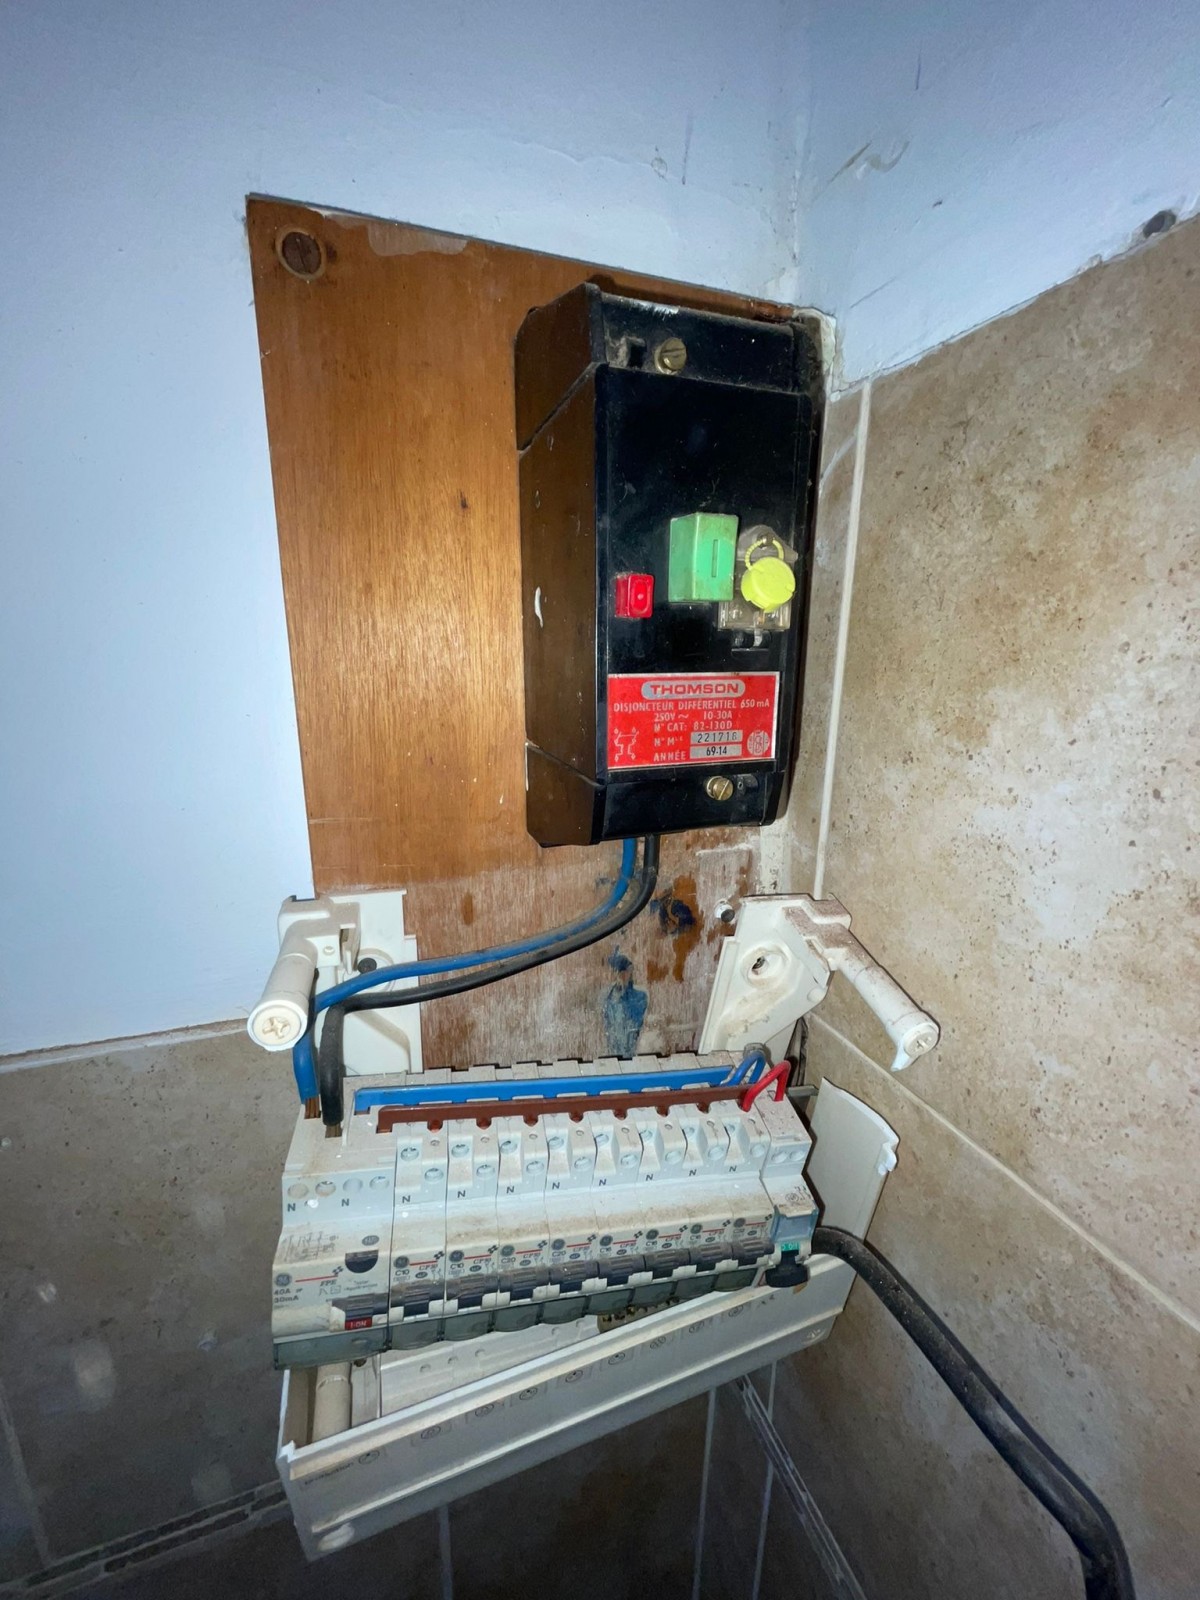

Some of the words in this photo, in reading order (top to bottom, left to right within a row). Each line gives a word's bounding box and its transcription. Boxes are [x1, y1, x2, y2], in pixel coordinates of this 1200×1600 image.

[650, 683, 739, 695] THOMSON
[613, 701, 674, 714] DISJONCTEUR
[740, 699, 756, 709] 650
[756, 698, 770, 708] mA
[654, 711, 676, 722] 250V
[693, 720, 733, 731] 82-130D
[653, 749, 687, 762] ANNÉE
[688, 1169, 697, 1177] N
[728, 1165, 737, 1173] N
[645, 1174, 653, 1182] N
[552, 1182, 560, 1190] N
[598, 1179, 607, 1187] N
[457, 1190, 466, 1198] N
[506, 1185, 515, 1194] N
[341, 1199, 350, 1207] N
[402, 1195, 411, 1204] N
[287, 1203, 296, 1212] N
